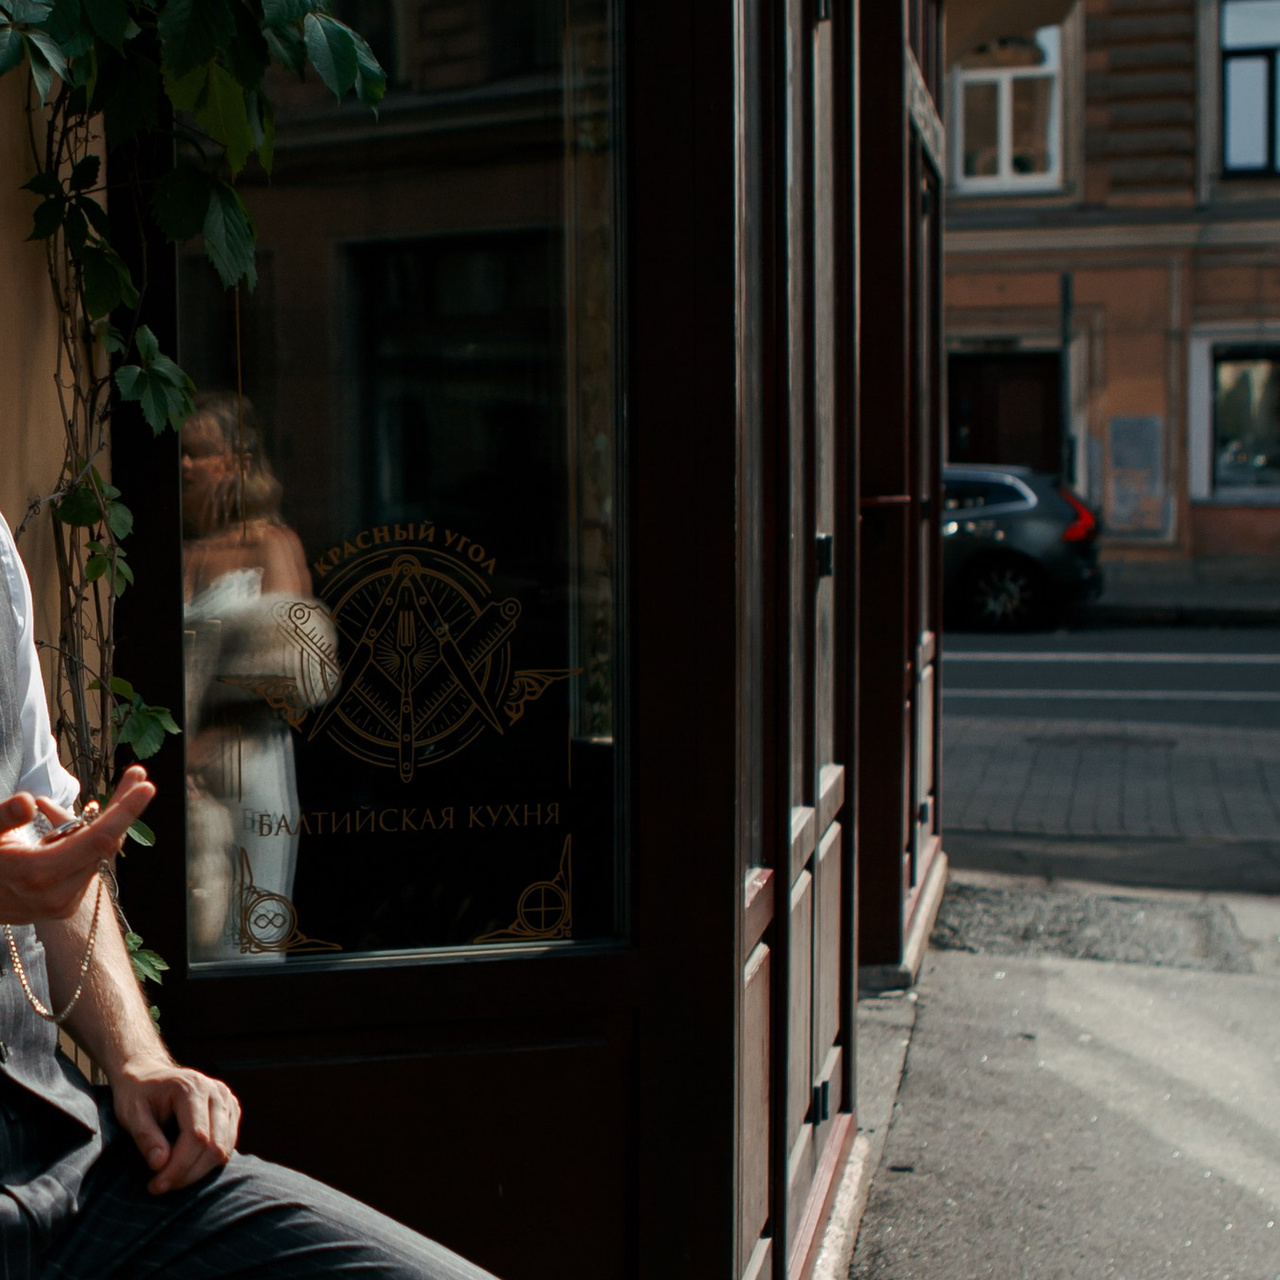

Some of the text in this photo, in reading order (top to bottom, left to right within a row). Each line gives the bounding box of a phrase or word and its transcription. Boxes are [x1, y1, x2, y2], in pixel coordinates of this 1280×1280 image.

[314, 519, 499, 577] КРАСНЫЙ УГОЛ
[258, 802, 561, 838] БАЛТИЙСКАЯ КУХНЯ
